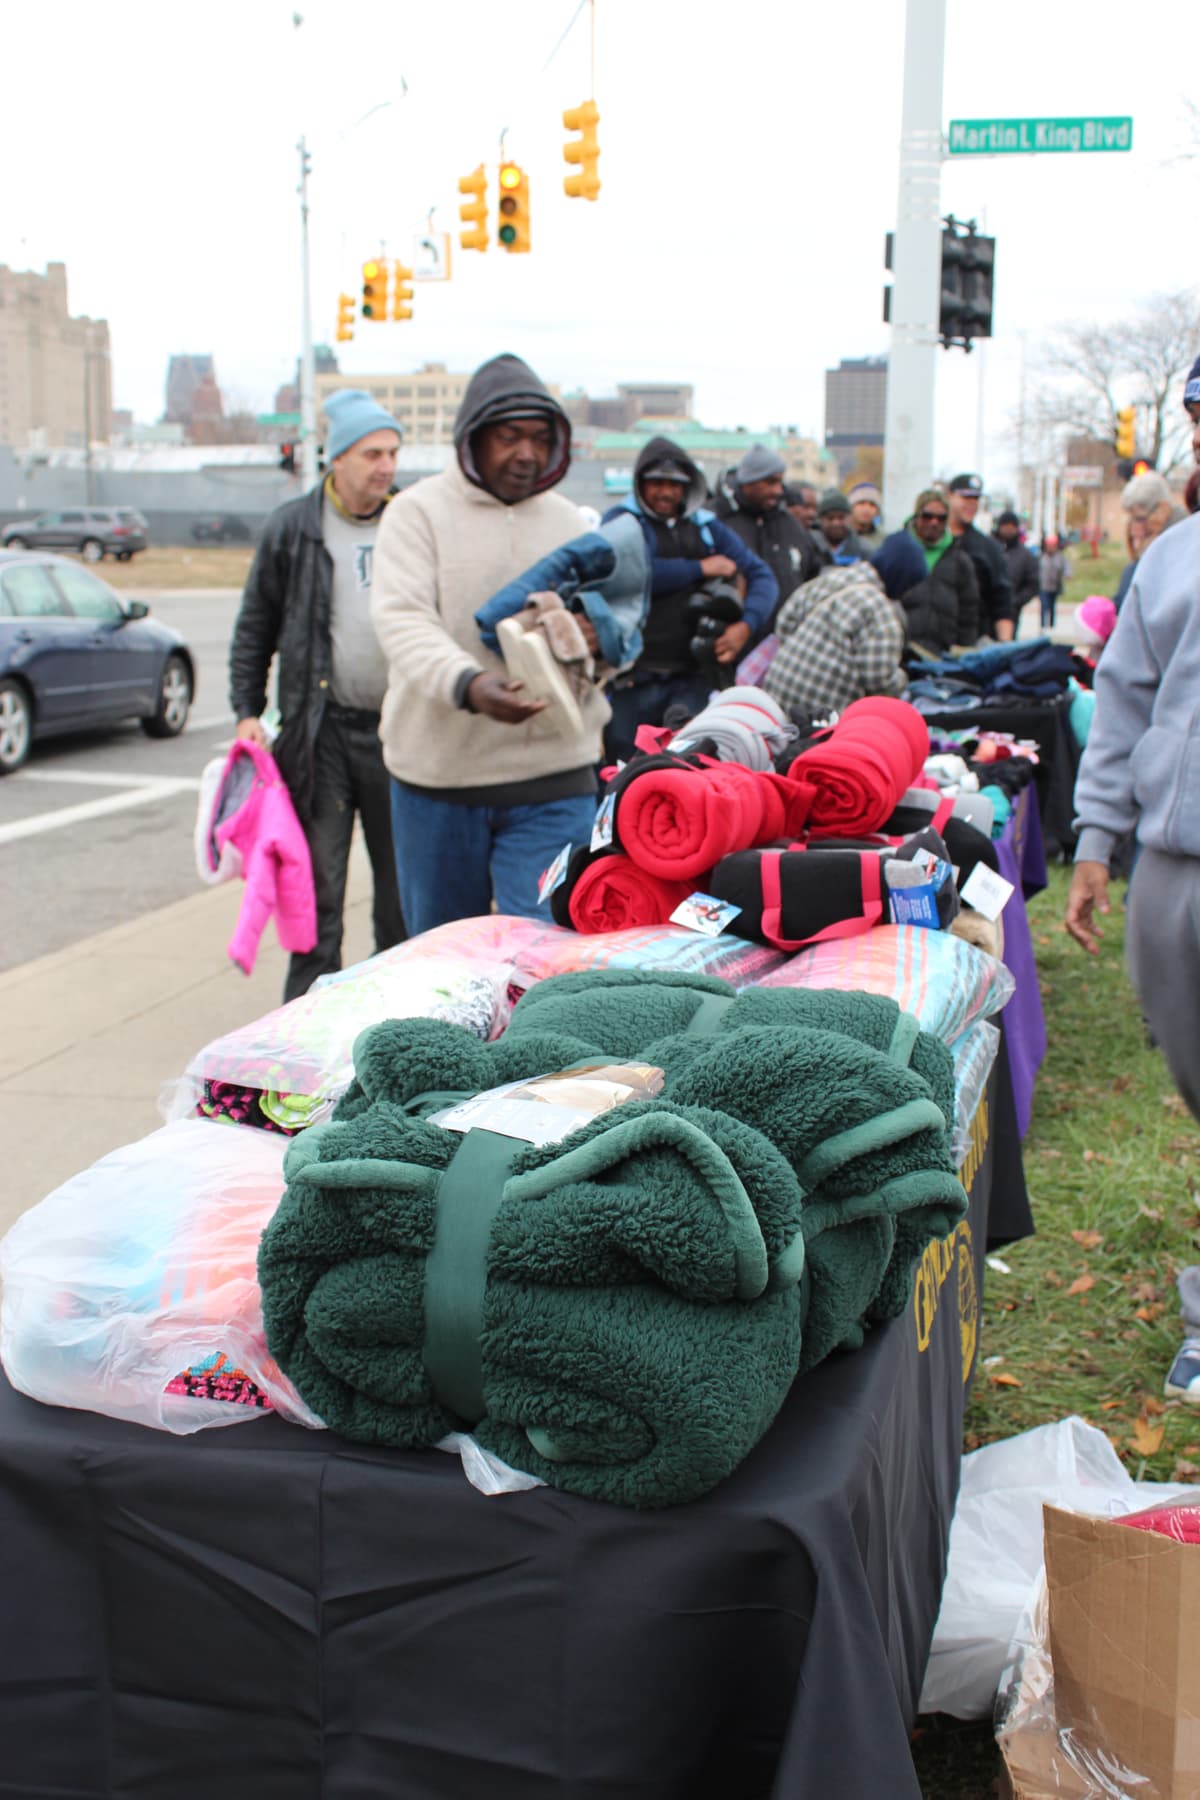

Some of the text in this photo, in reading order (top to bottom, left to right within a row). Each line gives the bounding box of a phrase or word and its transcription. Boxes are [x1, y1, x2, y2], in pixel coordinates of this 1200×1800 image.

[952, 120, 1129, 151] Martin L King Blvd
